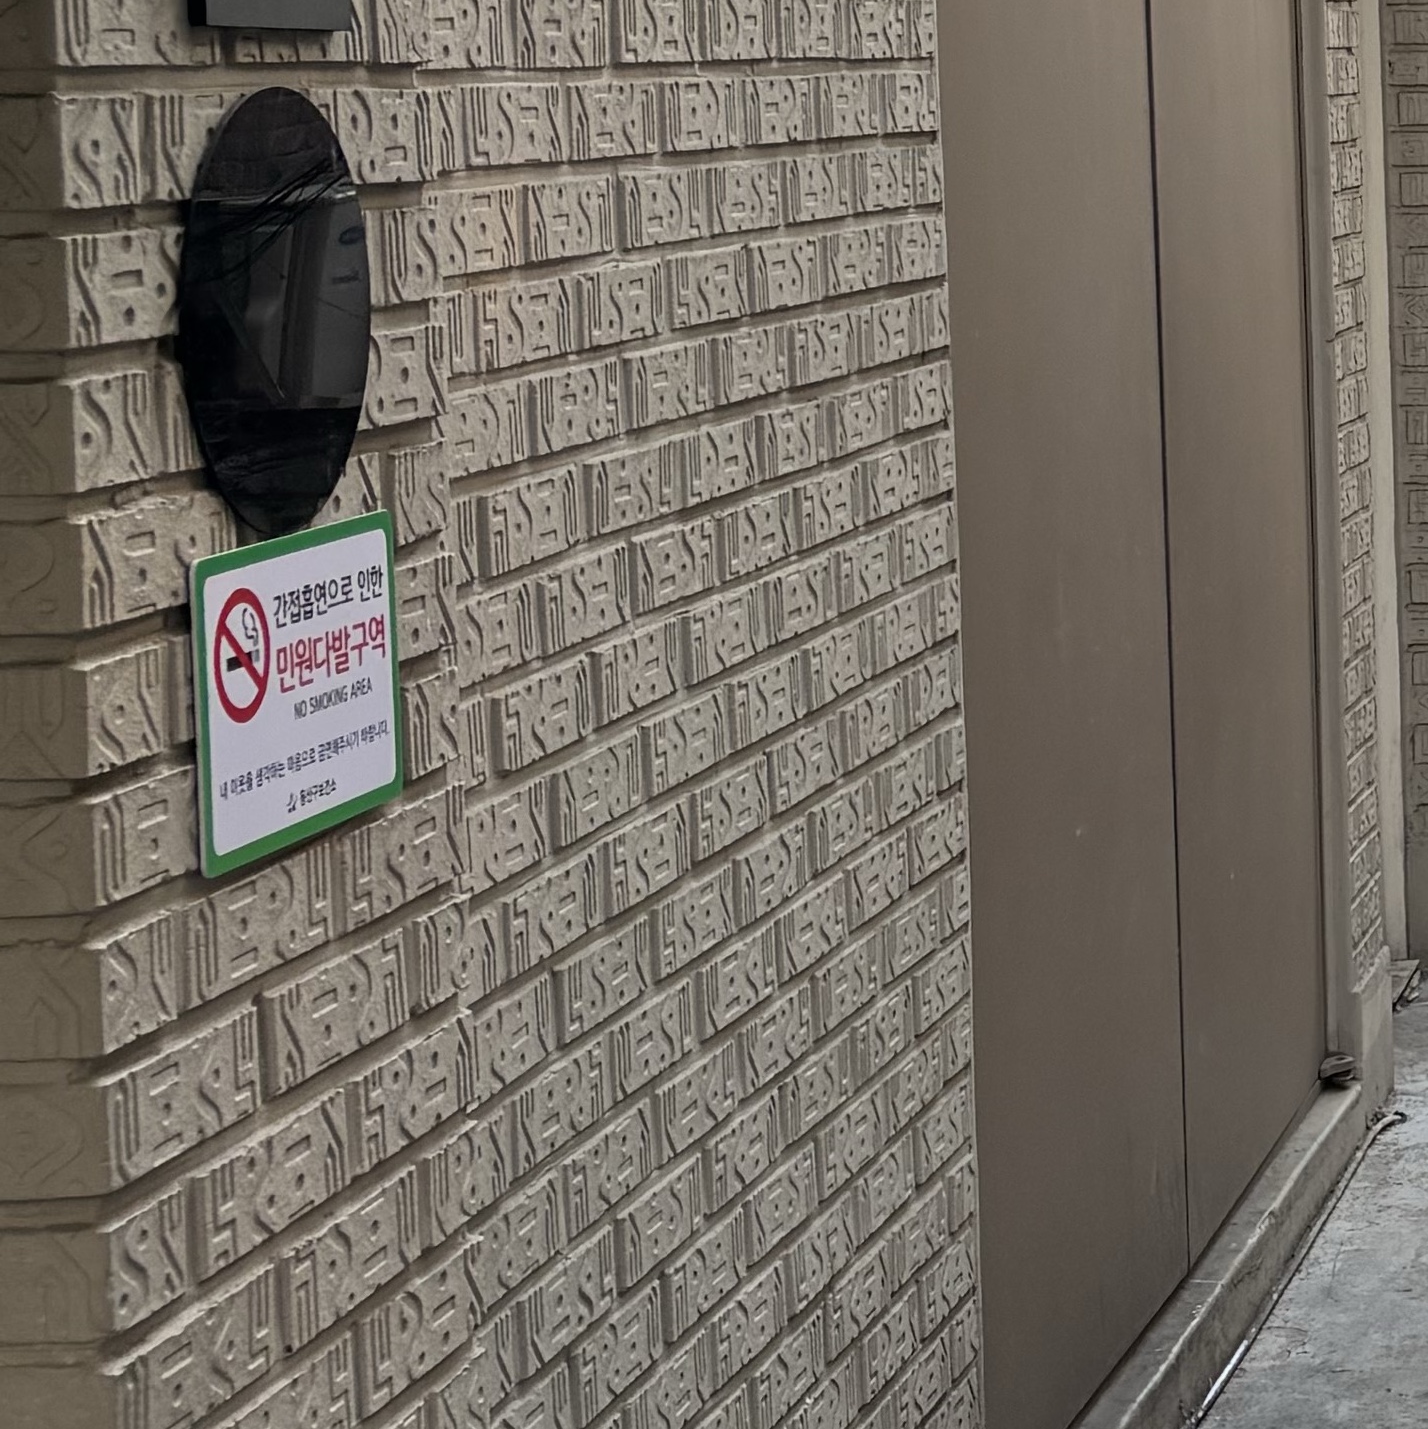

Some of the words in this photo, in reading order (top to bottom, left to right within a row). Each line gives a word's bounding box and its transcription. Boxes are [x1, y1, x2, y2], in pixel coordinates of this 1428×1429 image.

[273, 574, 354, 629] 간접흡연으로
[357, 564, 383, 602] 인한
[276, 614, 386, 694] 민원다발구역
[294, 699, 307, 720] NO
[309, 685, 348, 715] SMOKING
[350, 676, 373, 699] AREA
